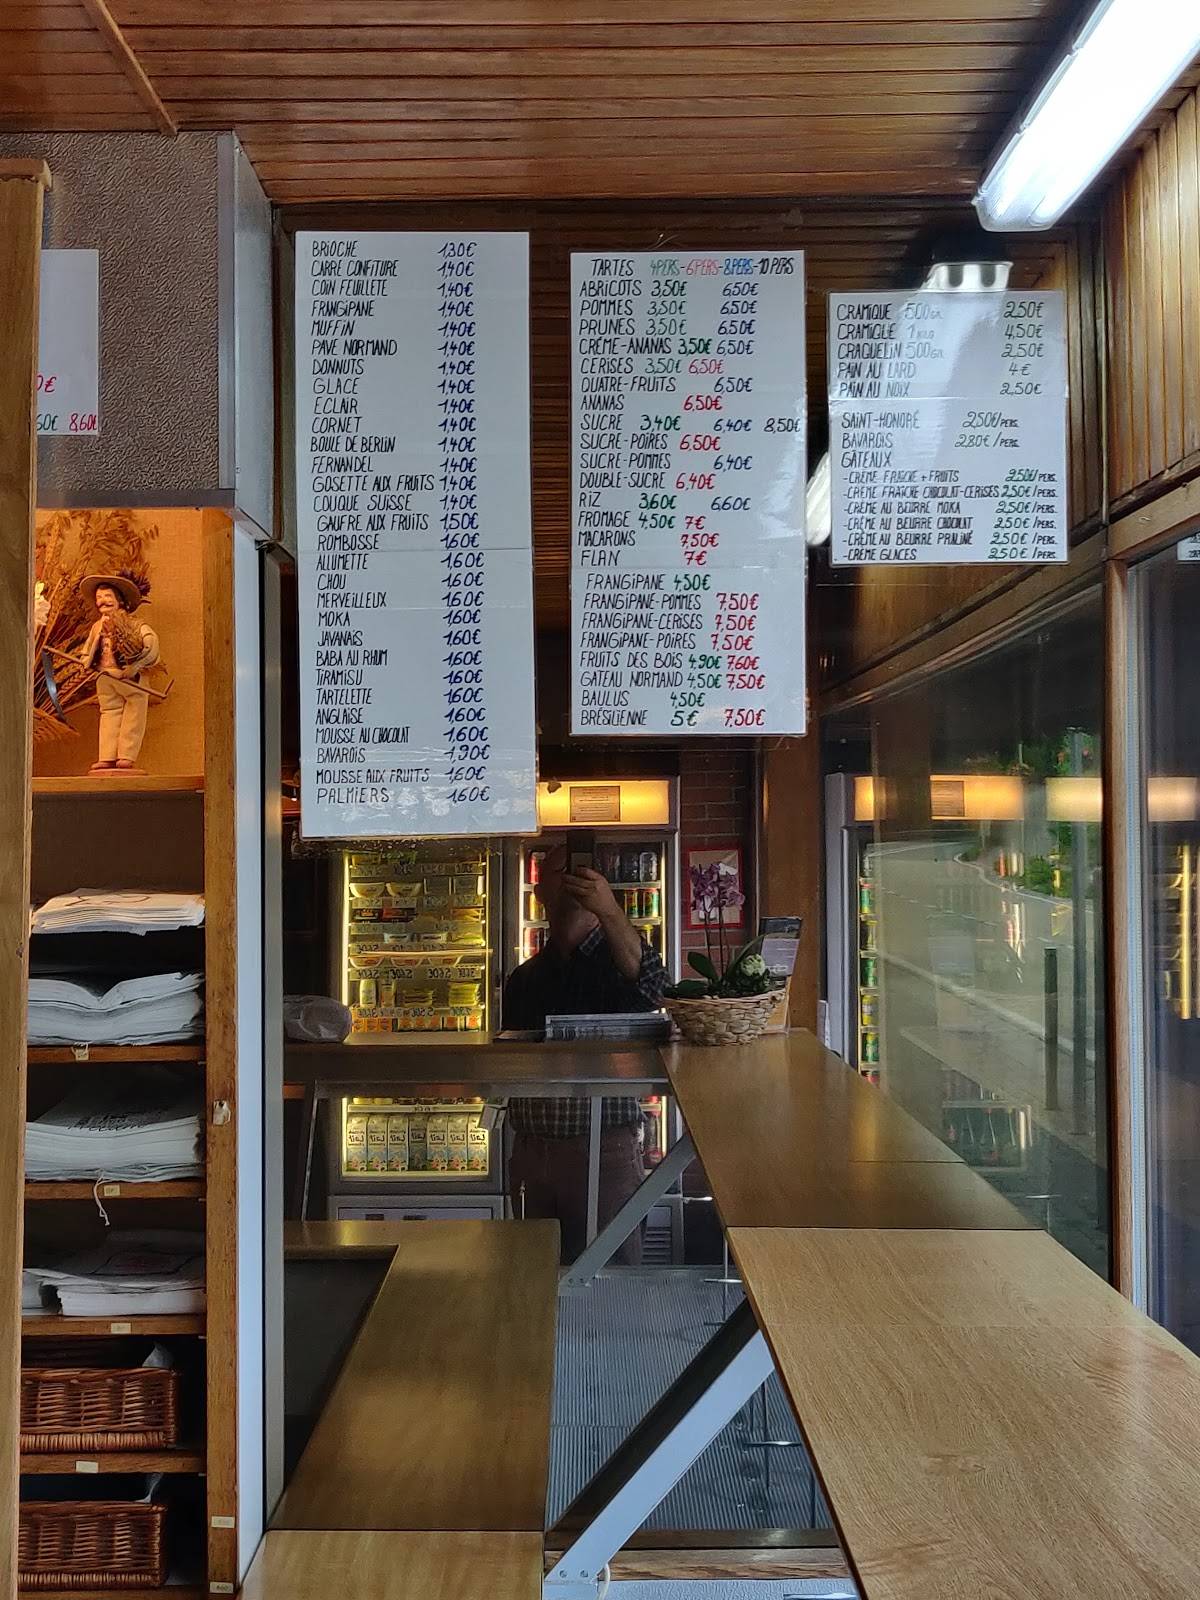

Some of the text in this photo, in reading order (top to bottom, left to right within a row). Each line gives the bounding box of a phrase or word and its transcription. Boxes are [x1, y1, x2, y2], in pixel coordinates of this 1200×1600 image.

[437, 242, 478, 257] 1,30€
[437, 260, 475, 277] 1,40€
[592, 259, 635, 277] TARTES
[437, 282, 474, 297] 1,40€
[651, 281, 688, 297] 3,50€
[723, 283, 759, 297] 6,50€
[437, 301, 475, 317] 1,40€
[580, 300, 758, 316] POMMES 3,50€ 6,50€
[438, 321, 476, 337] 1,40€
[579, 319, 687, 335] PRUNES 3,50€
[1004, 322, 1044, 339] 4,50€
[312, 339, 475, 356] PAVE NORMAND 1,40€
[678, 338, 755, 356] 3,50€ 6,50€
[313, 359, 475, 376] DONNUTS 1,40€
[644, 359, 682, 374] 3,50€
[689, 358, 725, 375] 6,50€
[866, 363, 882, 378] AU
[887, 363, 916, 378] LARD
[313, 378, 475, 394] GLACE 1,40€
[713, 377, 753, 395] 6,50€
[866, 382, 881, 397] AU
[999, 383, 1043, 396] 2,50€
[438, 399, 475, 415] 1,40€
[580, 395, 625, 410] ANANAS
[312, 417, 477, 433] CORNET 1,40€
[580, 414, 623, 431] SUCRE
[640, 415, 682, 433] 3,40€
[713, 418, 753, 433] 6,40€
[345, 437, 359, 452] DE
[438, 437, 477, 452] 1,40€
[312, 456, 478, 473] FERNANDEL 1,40€
[580, 453, 753, 472] SUCRE-POMMES 6,40€
[313, 475, 478, 492] GOSETTE AUX 1,40€
[580, 472, 717, 491] DOUBLE-SUCRE 6,40€
[314, 494, 478, 512] COUQUE 1,40€
[639, 493, 678, 509] 3,60€
[711, 497, 752, 511] 6,60€
[937, 502, 961, 514] MOKA
[317, 513, 479, 531] GAUFRE AUX 1,50€
[578, 511, 706, 530] FROMAGE 4,50€ 7€
[317, 533, 480, 551] ROMBOSSE 1,60€
[578, 531, 720, 549] MACARONS 7,50€
[316, 552, 485, 570] ALLUMETTE 1,60€
[581, 550, 707, 567] FLAN 7€
[317, 572, 485, 590] CHOU 1,60€
[674, 574, 712, 592] 4,50€
[441, 592, 484, 608] 1,60€
[716, 593, 759, 611] 7,50€
[318, 610, 481, 627] MOKA 1,60€
[715, 614, 757, 632] 7,50€
[443, 630, 481, 646] 1,60€
[711, 633, 755, 652] 7,50€
[316, 649, 482, 667] BABA AU RHUM 1,60€
[627, 653, 648, 668] DES
[688, 655, 722, 670] 4,90€
[727, 655, 760, 670] 7,60€
[443, 669, 483, 685] 1,60€
[629, 671, 683, 689] NORMAND
[687, 673, 722, 690] 4,50€
[726, 674, 767, 692] 7,50€
[316, 688, 484, 705] TARTELETTE 1,60€
[581, 691, 706, 709] BAULUS 4,50€
[444, 708, 486, 723] 1,60€
[724, 709, 767, 728] 7,50€
[316, 727, 356, 744] MOUSSE
[360, 727, 371, 743] AU
[444, 727, 489, 743] 1,60€
[316, 766, 486, 784] MOUSSE AUX 1,60€
[447, 787, 490, 803] 1,60€
